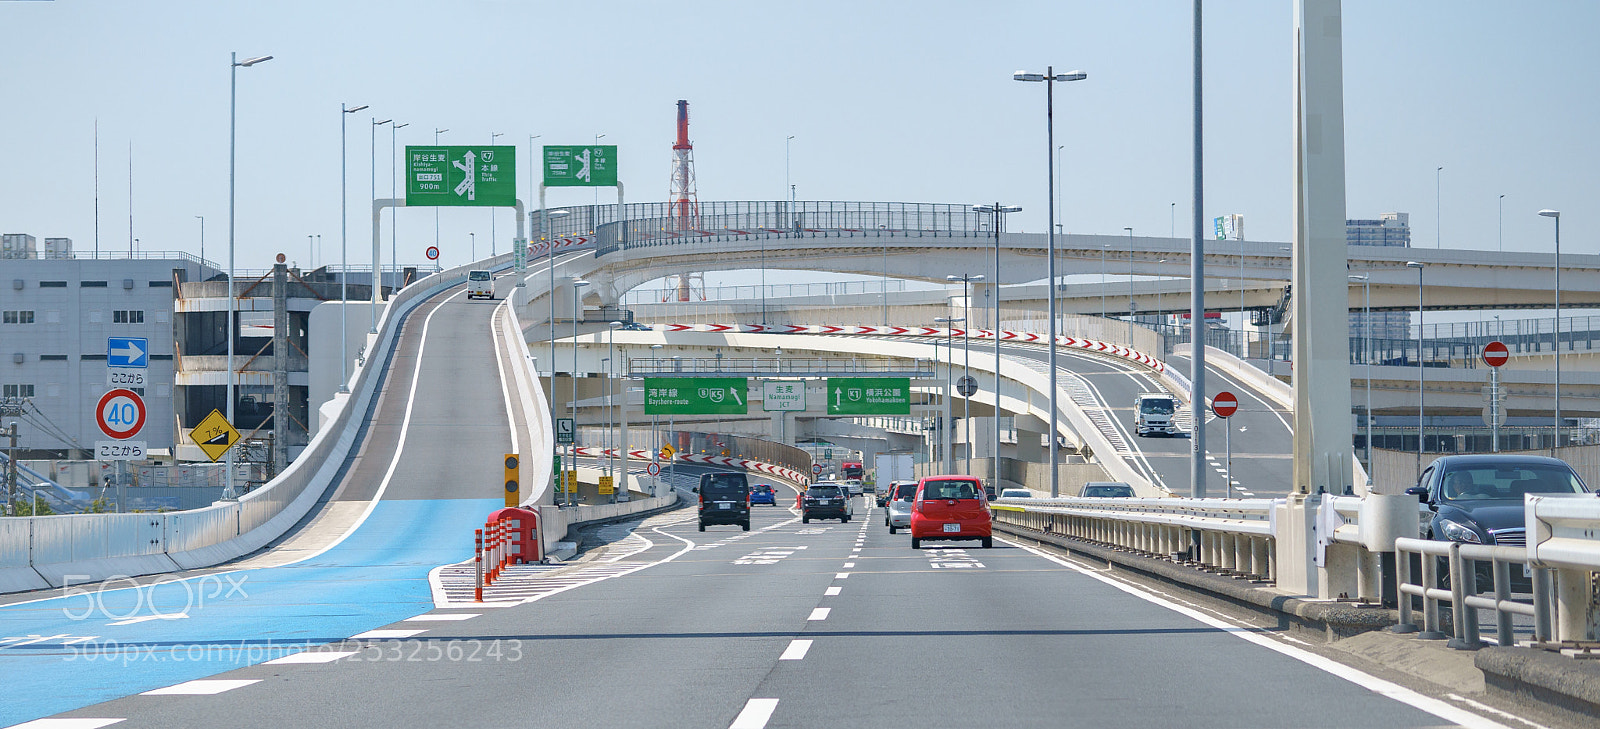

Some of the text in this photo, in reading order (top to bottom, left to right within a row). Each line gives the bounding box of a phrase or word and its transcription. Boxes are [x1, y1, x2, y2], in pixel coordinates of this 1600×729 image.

[112, 373, 144, 384] ここから
[648, 388, 678, 398] 湾岸線
[712, 390, 722, 399] K5
[776, 386, 793, 394] 生麦
[866, 388, 900, 397] 横浜公園
[108, 403, 134, 425] 40
[205, 426, 222, 438] 7%
[100, 446, 142, 456] ここから
